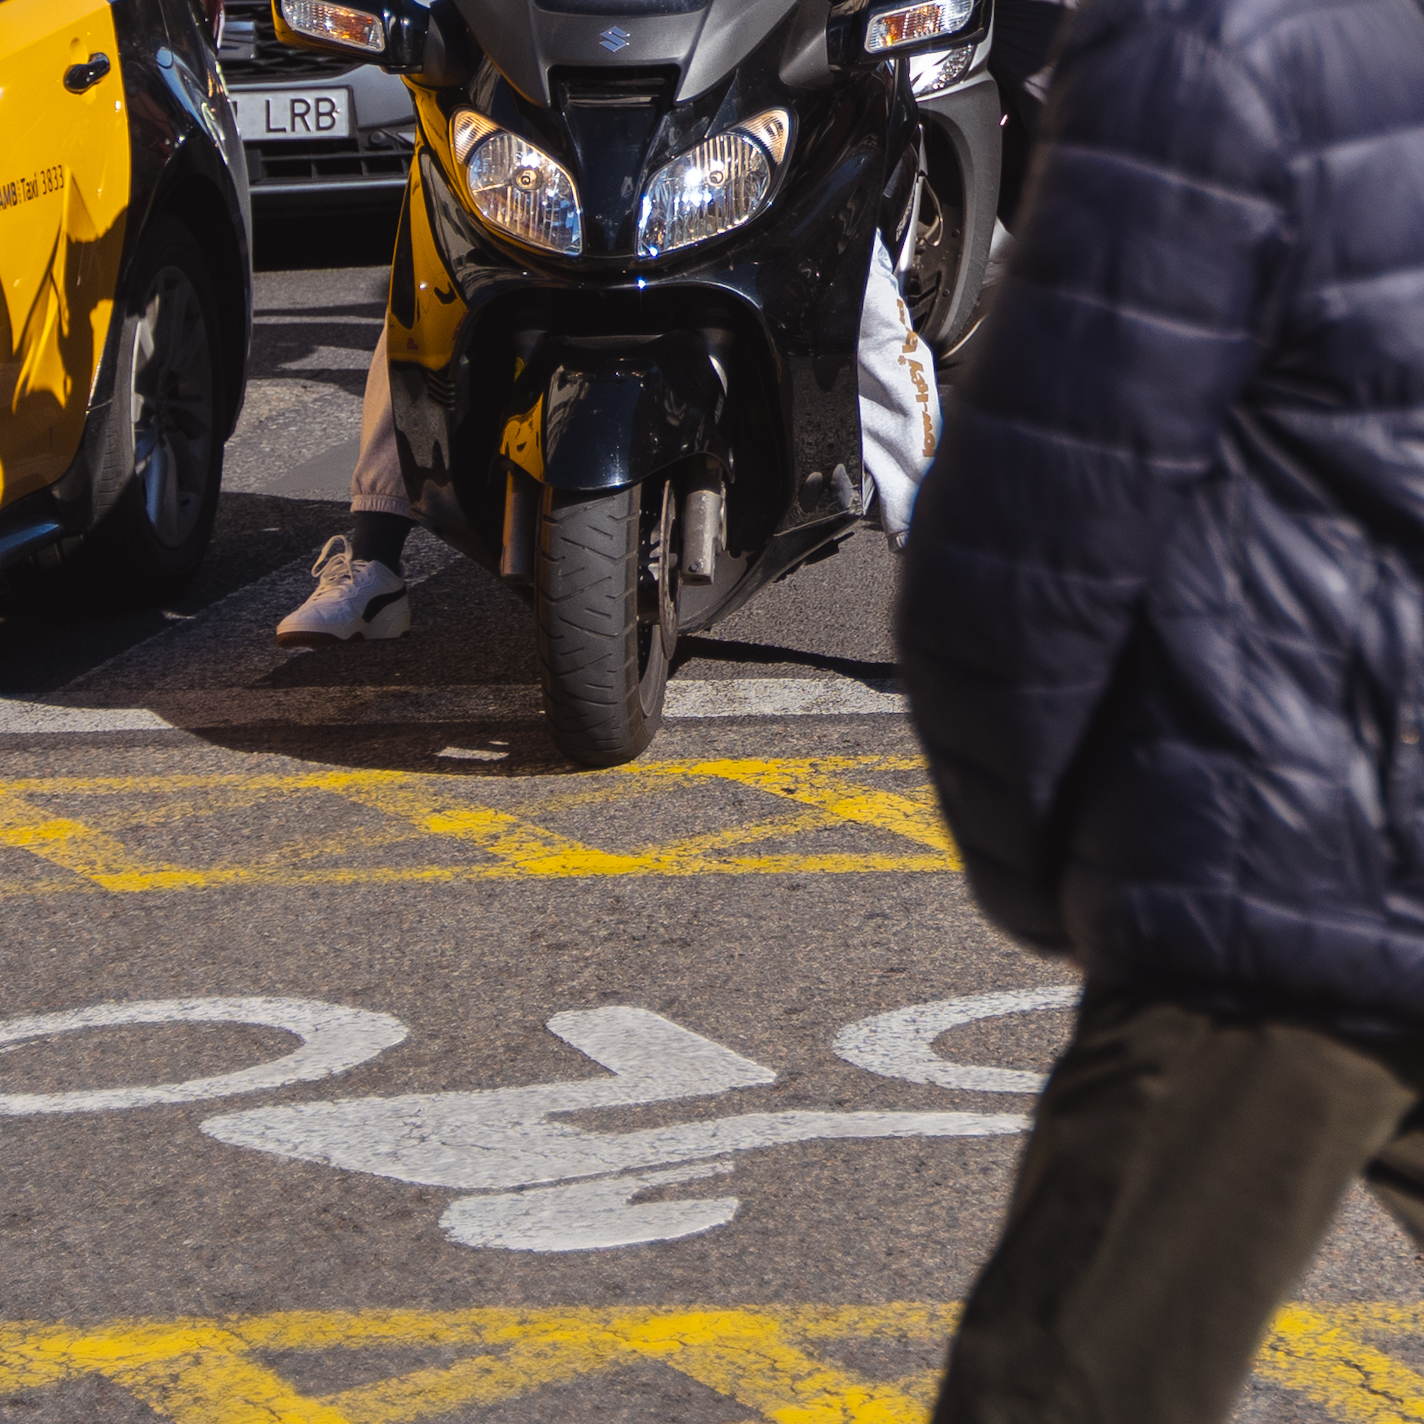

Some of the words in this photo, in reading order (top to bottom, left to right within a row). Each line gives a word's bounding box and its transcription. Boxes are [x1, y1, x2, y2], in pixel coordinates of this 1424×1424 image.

[265, 97, 336, 133] LRB
[20, 172, 39, 203] Taxi
[40, 164, 65, 195] 3833
